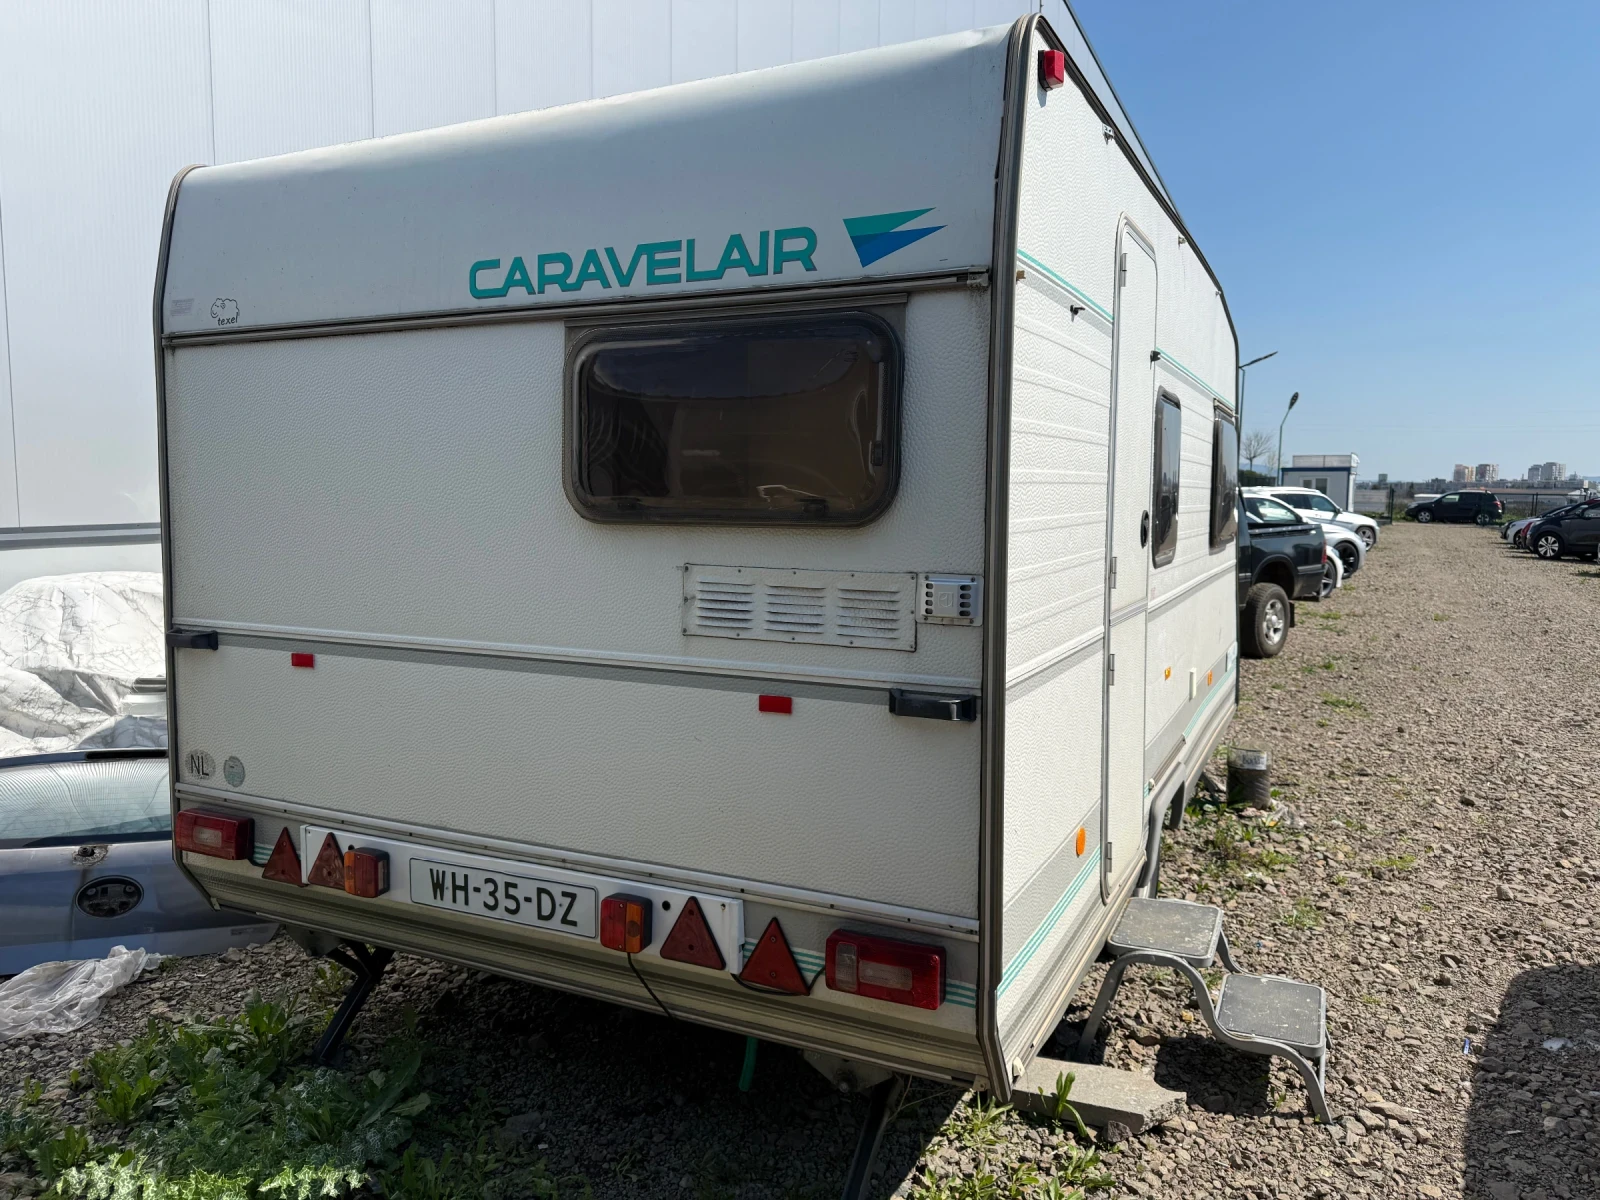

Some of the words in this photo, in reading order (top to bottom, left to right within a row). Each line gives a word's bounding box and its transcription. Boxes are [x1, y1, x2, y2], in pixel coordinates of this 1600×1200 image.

[469, 226, 818, 300] CARAVELAIR
[217, 313, 238, 326] texel
[190, 754, 210, 776] NL
[429, 868, 578, 927] WH-35-DZ
